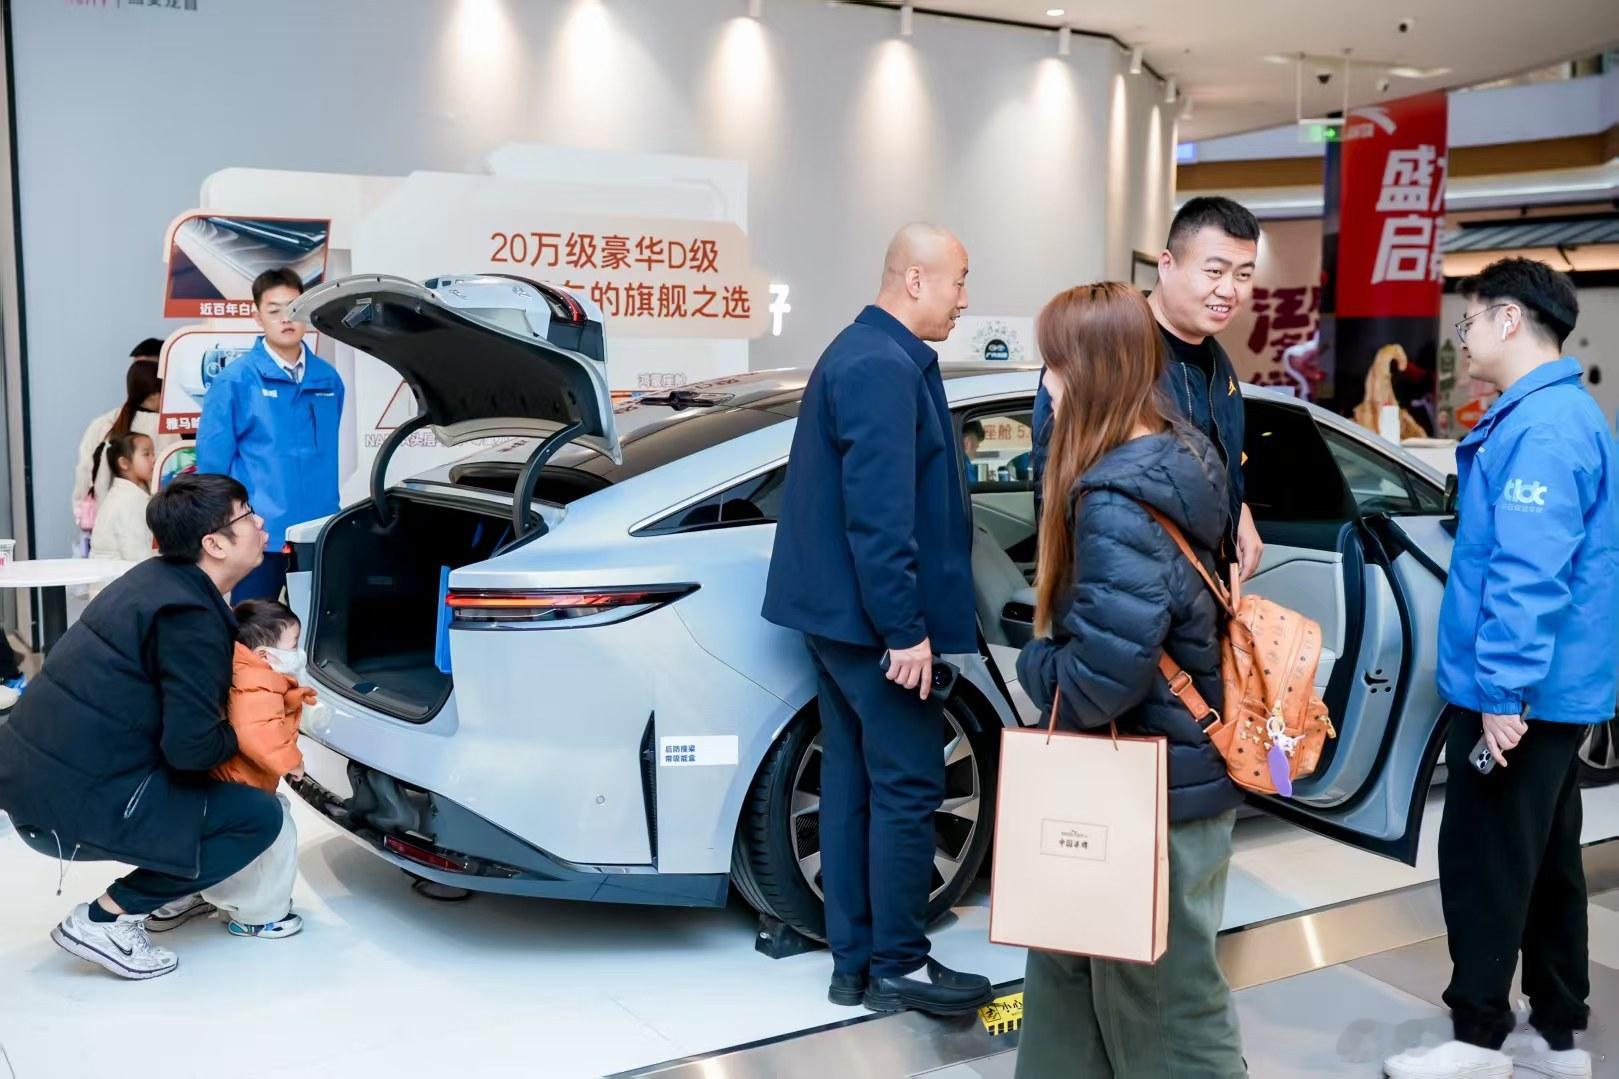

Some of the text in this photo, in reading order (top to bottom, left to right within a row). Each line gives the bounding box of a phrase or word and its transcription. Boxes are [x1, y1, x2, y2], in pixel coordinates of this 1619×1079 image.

[490, 232, 719, 273] 20万级豪华D级
[563, 280, 751, 319] 的旗舰之选
